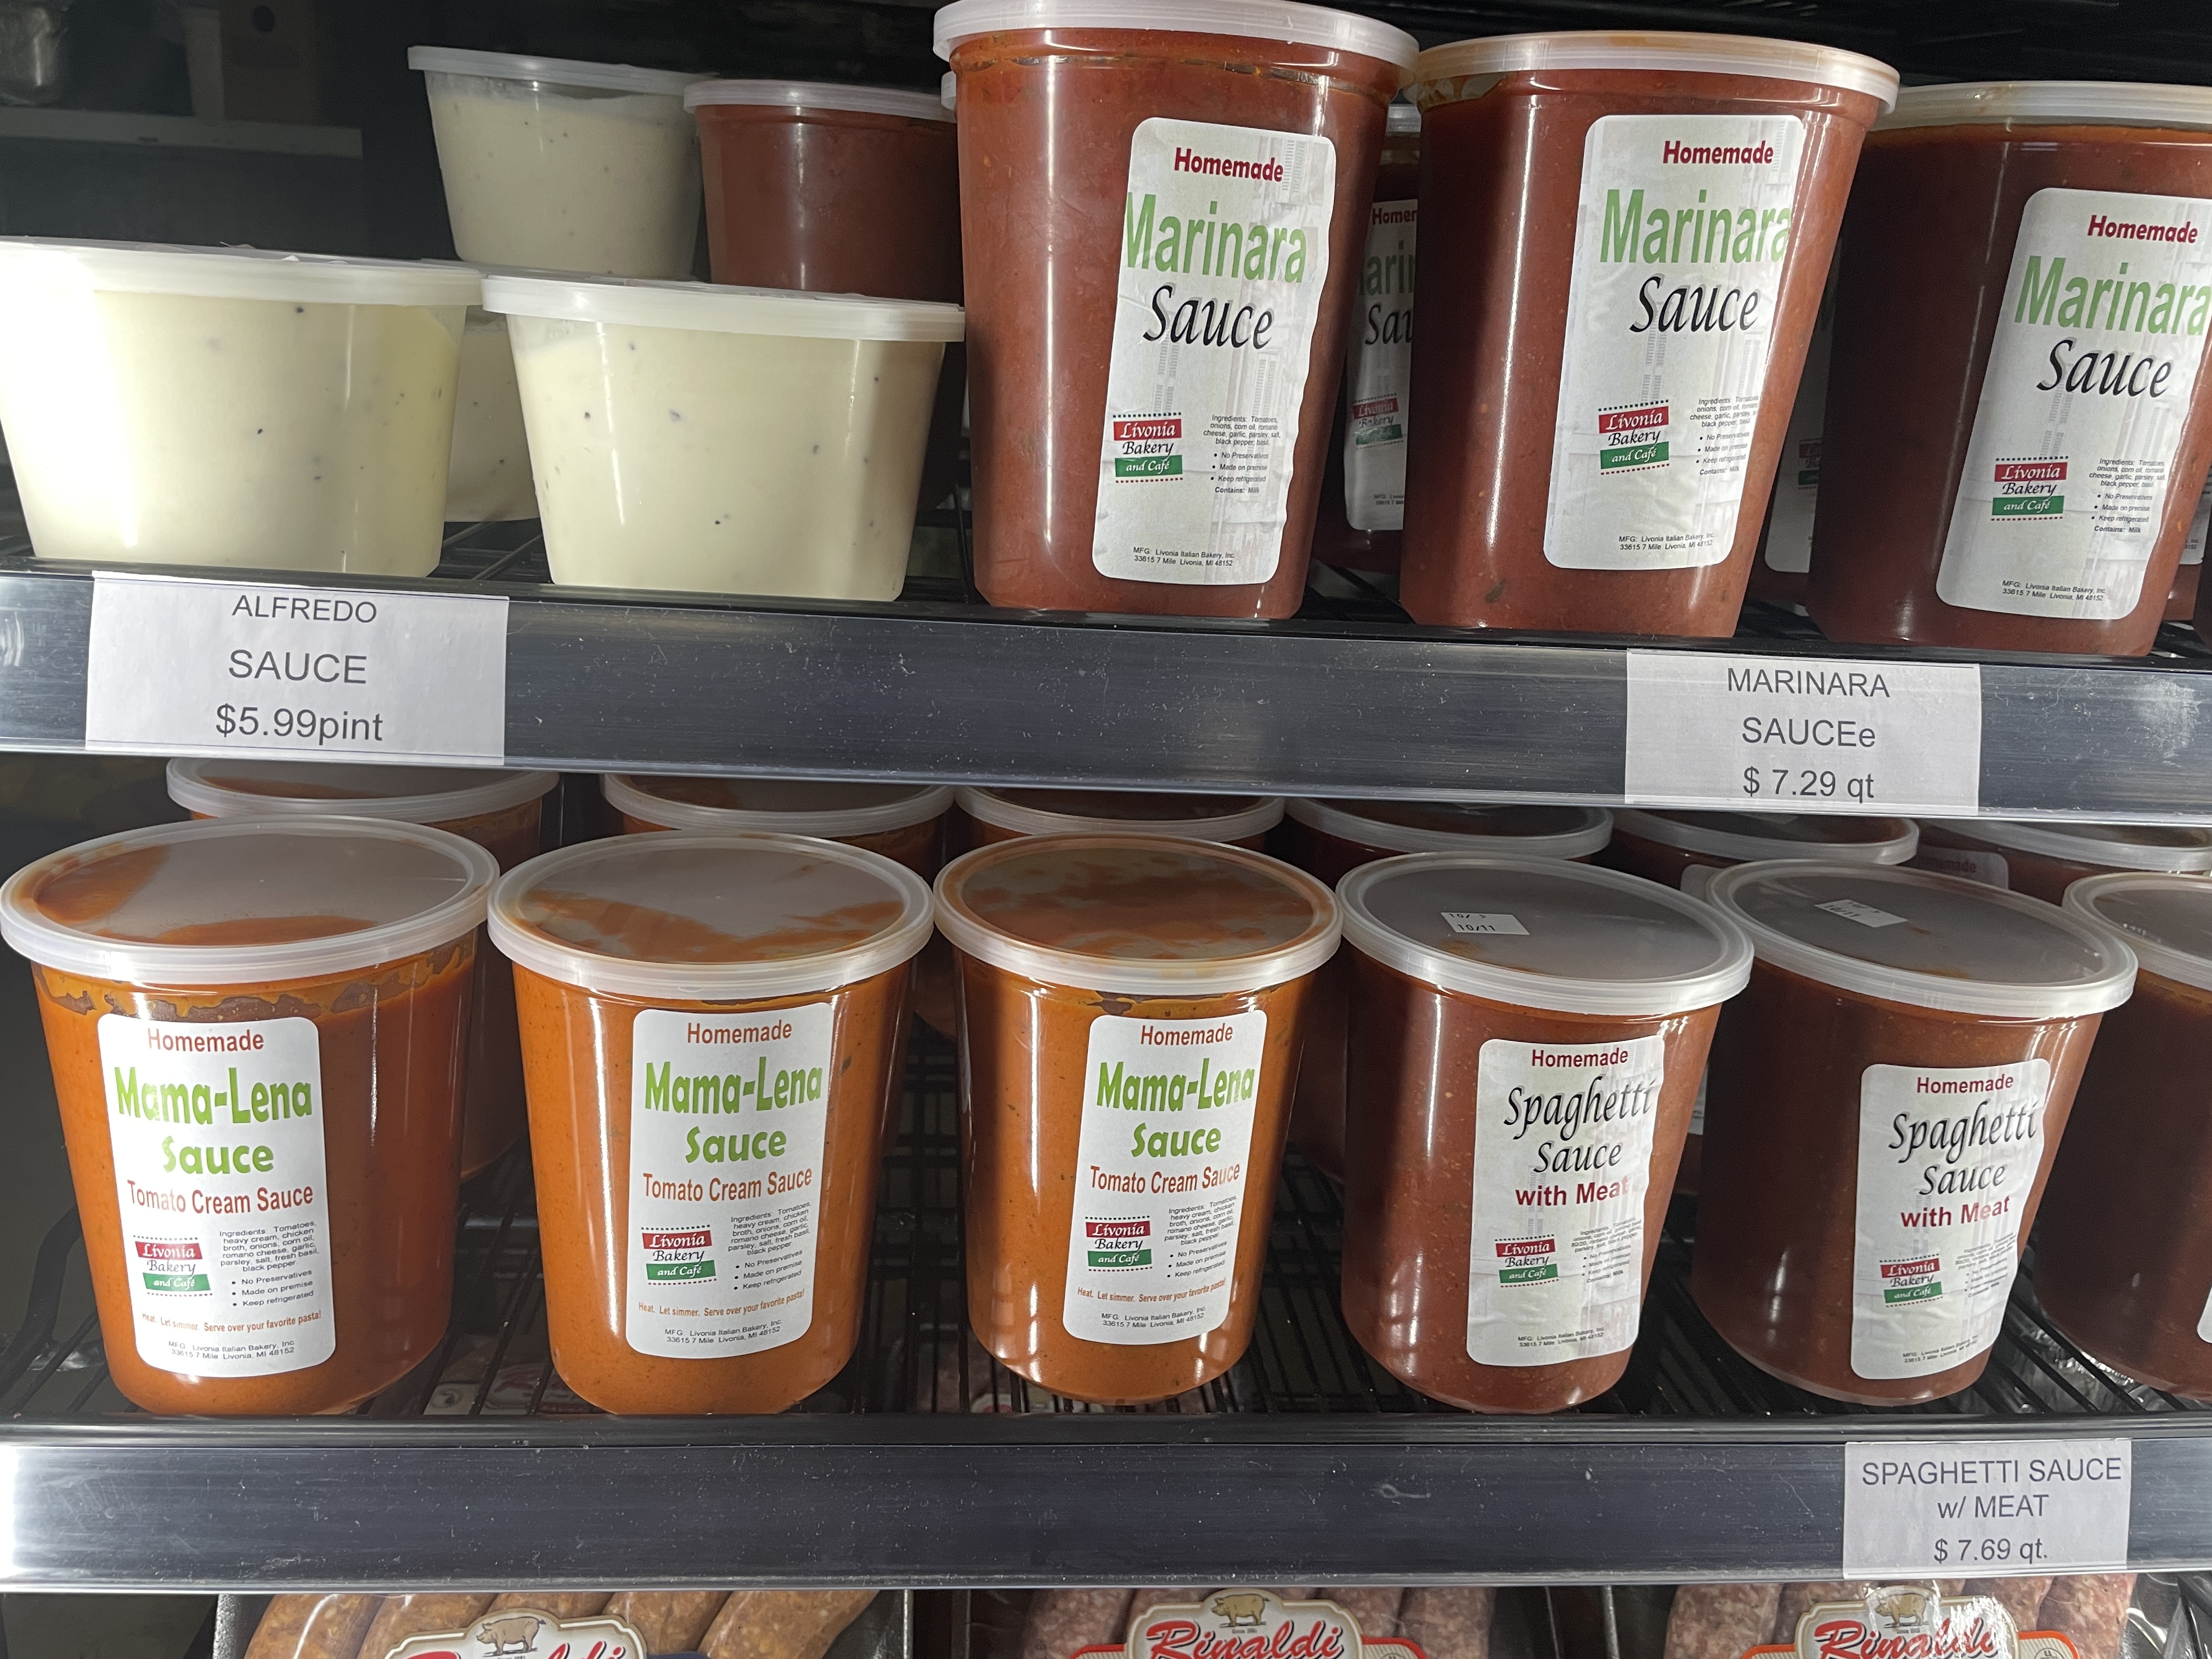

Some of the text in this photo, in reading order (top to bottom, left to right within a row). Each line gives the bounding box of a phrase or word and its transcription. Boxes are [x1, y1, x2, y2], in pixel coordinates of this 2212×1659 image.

[1663, 140, 1773, 164] Homemade
[1174, 148, 1284, 182] Homemade
[1126, 191, 1307, 284] Marinara
[1600, 189, 1792, 263] Marinara
[2087, 215, 2198, 243] Homemade
[1629, 276, 1758, 333] Sauce
[2015, 255, 2212, 335] Marinara
[1143, 285, 1273, 350] Sauce
[2036, 340, 2171, 397] Sauce
[1120, 421, 1176, 438] Livonia
[1605, 410, 1662, 430] Livonia
[1122, 438, 1174, 460] Bakery
[1608, 429, 1661, 448] Bakery
[1126, 458, 1170, 474] and Café
[1612, 447, 1657, 463] and Café
[2001, 465, 2061, 480] Livonia
[2002, 481, 2057, 498] Bakery
[2004, 498, 2051, 514] and Café
[232, 595, 377, 623] ALFREDO
[228, 650, 368, 685] SAUCE
[1728, 668, 1890, 697] MARINARA
[215, 703, 383, 746] $5.99pint
[1742, 717, 1876, 747] SAUCEe
[1771, 769, 1836, 797] 7.29
[1847, 772, 1874, 803] qt
[148, 1028, 264, 1053] Homemade
[687, 1019, 792, 1045] Homemade
[1141, 1023, 1233, 1046] Homemade
[1532, 1047, 1629, 1068] Homemade
[114, 1066, 313, 1125] Mama-Lena
[645, 1056, 823, 1115] Mama-Lena
[1097, 1058, 1255, 1112] Mama-Lena
[1917, 1074, 2014, 1094] Homemade
[1503, 1073, 1657, 1141] Spaghetti
[1131, 1122, 1221, 1158] Sauce
[1888, 1099, 2038, 1164] Spaghetti
[162, 1135, 274, 1175] Sauce
[685, 1126, 787, 1164] Sauce
[1533, 1141, 1623, 1173] Sauce
[643, 1167, 812, 1202] Tomato Cream Sauce
[1090, 1163, 1240, 1194] Tomato Cream Sauce
[1515, 1175, 1629, 1207] with Meat
[1919, 1164, 2006, 1196] Sauce
[127, 1179, 313, 1215] Tomato Cream Sauce
[1900, 1195, 2010, 1228] with Meat
[273, 1221, 317, 1233] Tomatoes,
[282, 1228, 314, 1239] chicken
[1092, 1223, 1145, 1237] Livonia
[143, 1243, 195, 1259] Livonia
[649, 1233, 707, 1248] Livonia
[1094, 1237, 1143, 1254] Bakery
[1502, 1242, 1550, 1255] Livonia
[147, 1260, 196, 1276] Bakery
[275, 1253, 296, 1262] fresh
[653, 1249, 705, 1265] Bakery
[1098, 1251, 1140, 1266] and Café
[1505, 1255, 1549, 1269] Bakery
[1887, 1261, 1934, 1276] Livonia
[256, 1269, 312, 1284] Preservatives
[657, 1264, 702, 1278] and Café
[1509, 1267, 1546, 1280] and Café
[1890, 1274, 1934, 1288] Bakery
[154, 1277, 196, 1291] and Café
[280, 1280, 313, 1293] premise
[1894, 1288, 1913, 1299] and
[267, 1290, 314, 1305] refrigerated
[659, 1306, 670, 1315] Let
[672, 1307, 700, 1317] simmer.
[704, 1307, 724, 1316] Serve
[726, 1307, 741, 1315] over
[743, 1304, 759, 1316] your
[760, 1297, 785, 1310] favorite
[786, 1288, 804, 1305] pasta!
[759, 1326, 781, 1336] 48152
[1863, 1458, 2121, 1485] SPAGHETTI SAUCE
[1937, 1494, 2049, 1519] w/ MEAT
[1958, 1538, 2011, 1561] 7.69
[2019, 1538, 2048, 1564] qt.
[1146, 1620, 1344, 1659] Rinaldi
